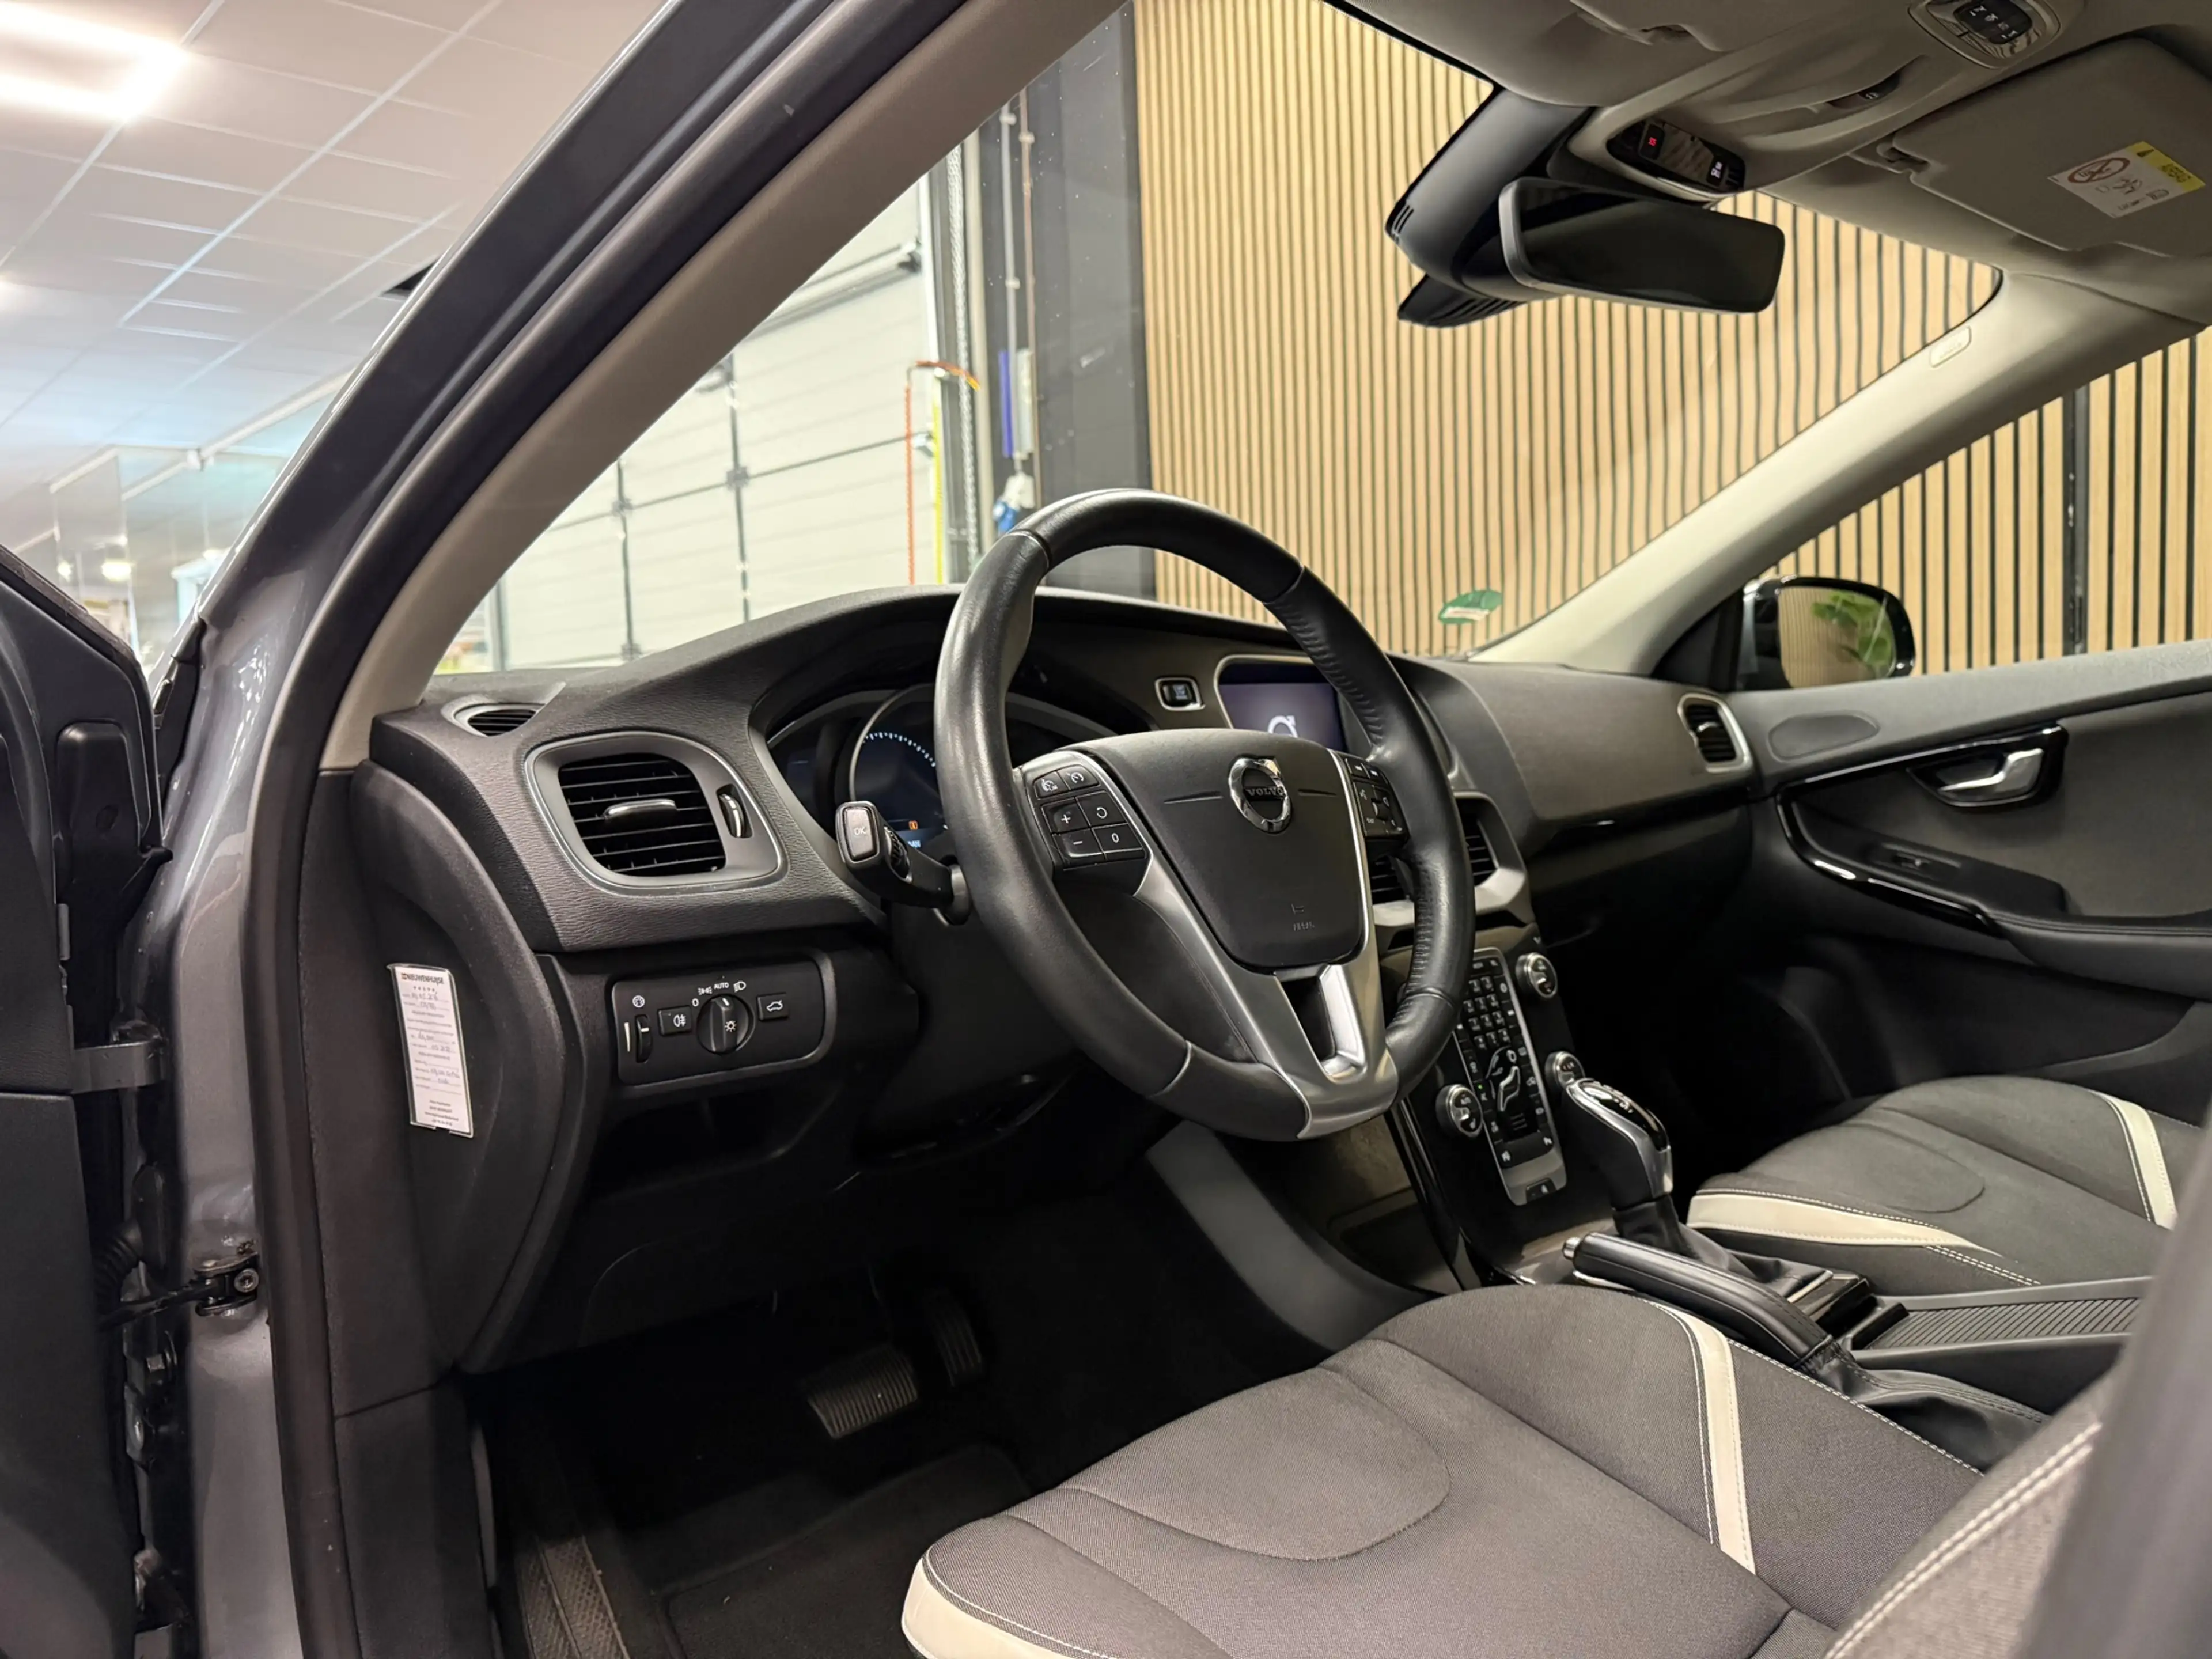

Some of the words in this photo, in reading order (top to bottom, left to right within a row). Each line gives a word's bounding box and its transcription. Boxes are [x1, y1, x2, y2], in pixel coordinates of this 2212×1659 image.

[1245, 787, 1283, 796] VOLVO
[854, 827, 866, 835] OK
[714, 982, 729, 990] AUTO
